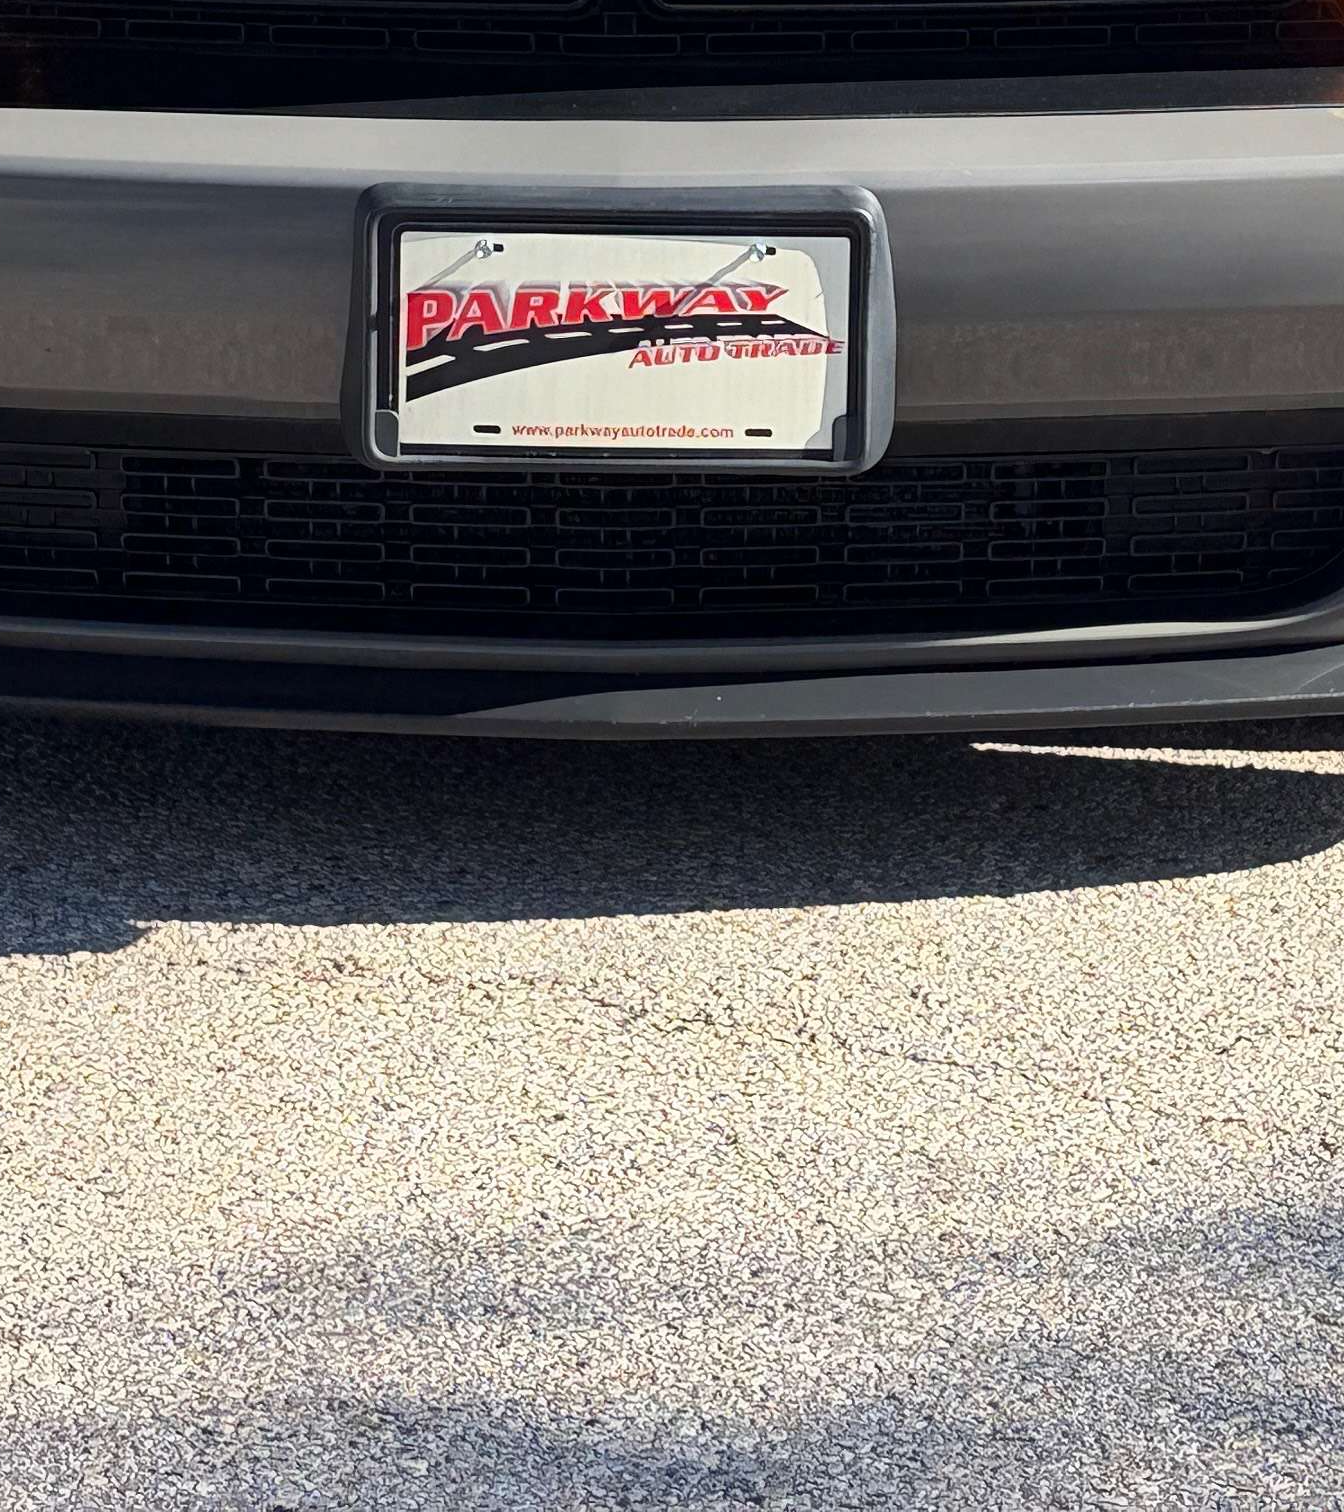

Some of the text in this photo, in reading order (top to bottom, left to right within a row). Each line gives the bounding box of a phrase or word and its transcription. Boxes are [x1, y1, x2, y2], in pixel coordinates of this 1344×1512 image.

[406, 285, 789, 350] PARKWAY
[629, 337, 844, 368] AUTO TRADE
[512, 424, 734, 440] www.parkwayautotrade.com
